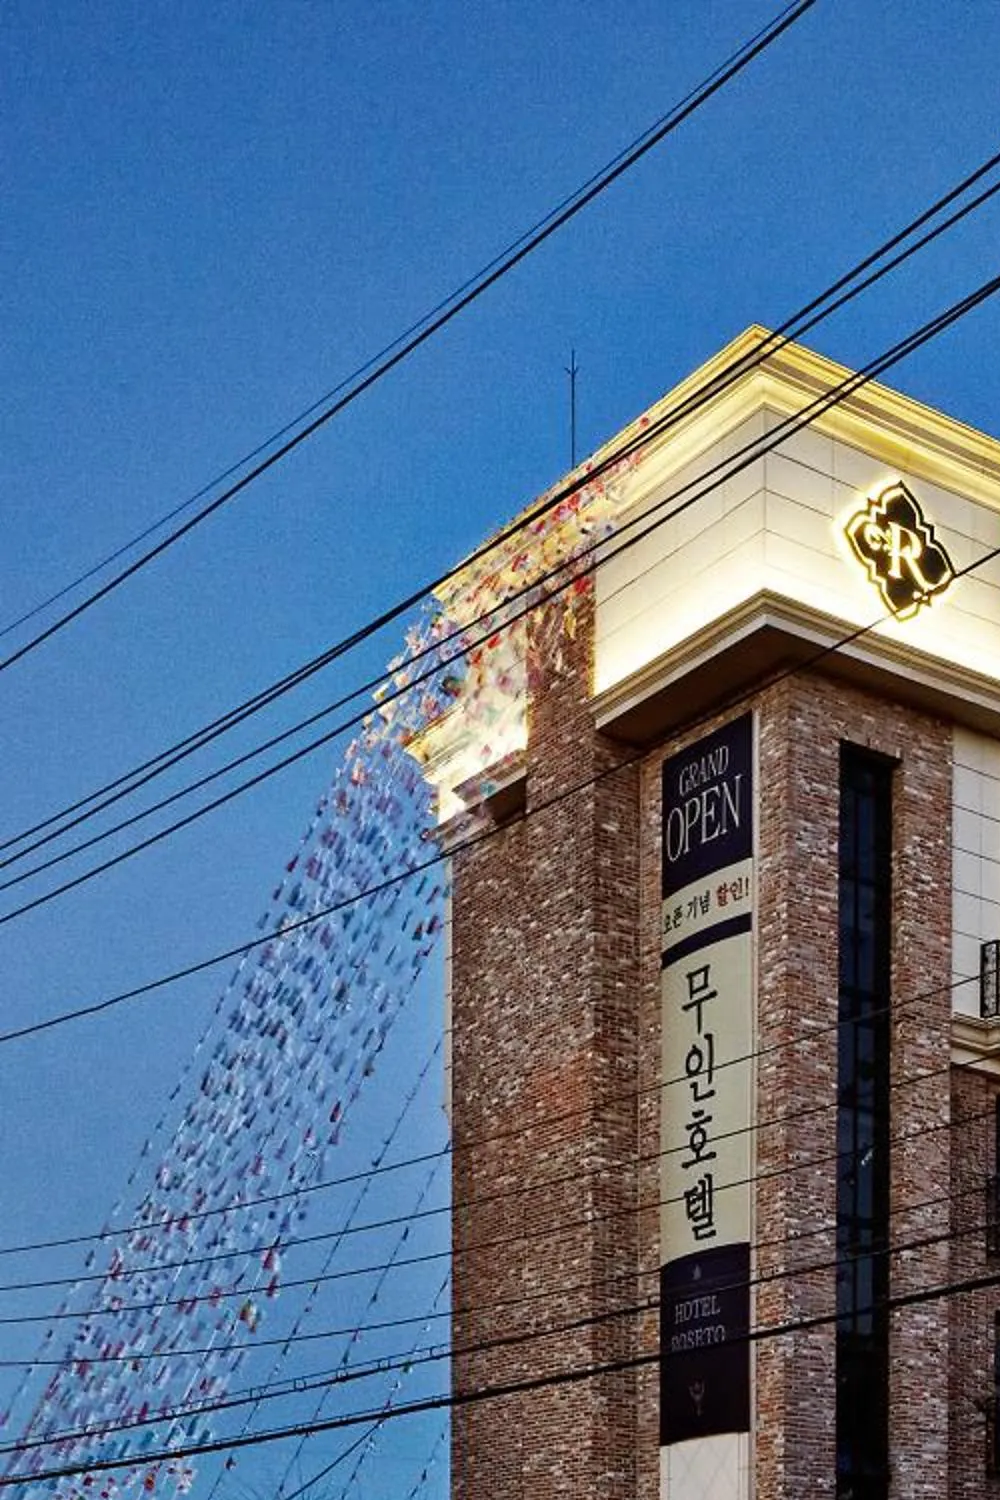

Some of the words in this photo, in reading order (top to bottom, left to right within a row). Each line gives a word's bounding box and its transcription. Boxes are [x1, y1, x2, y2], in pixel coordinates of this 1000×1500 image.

[678, 745, 730, 797] GRAND
[666, 774, 744, 862] OPEN
[681, 963, 718, 1242] 무인호텔
[674, 1294, 721, 1325] HOTEL
